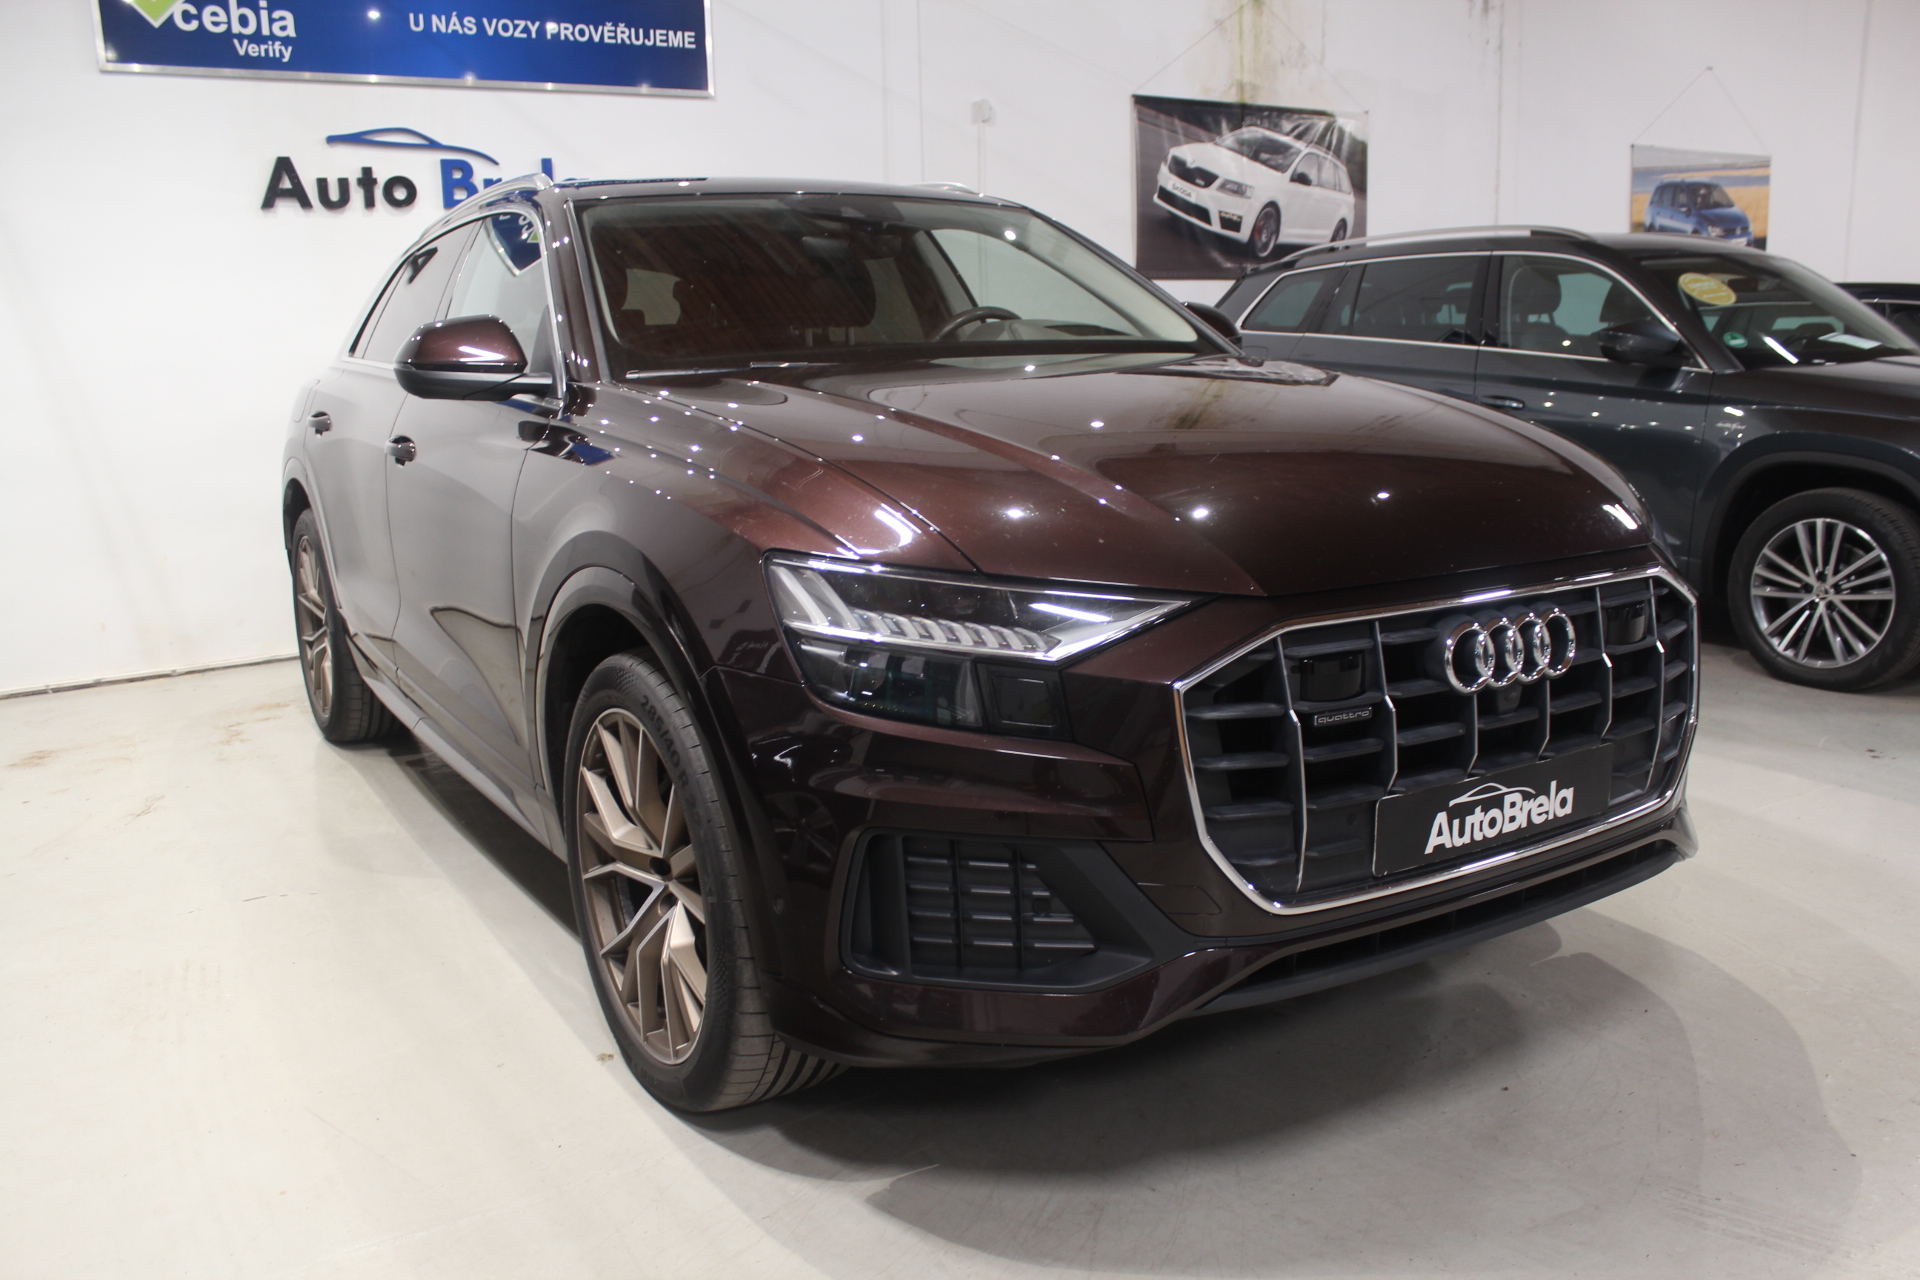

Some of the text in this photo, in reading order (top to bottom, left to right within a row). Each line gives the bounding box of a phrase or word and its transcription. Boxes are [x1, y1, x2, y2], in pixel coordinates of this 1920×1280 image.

[173, 0, 297, 37] cebia
[409, 11, 697, 49] U NÁS VOZY PROVĚŘUJEME
[233, 38, 293, 62] Verify
[261, 156, 418, 209] Auto
[1318, 709, 1370, 724] quattro
[1424, 780, 1575, 855] AutoBrela
